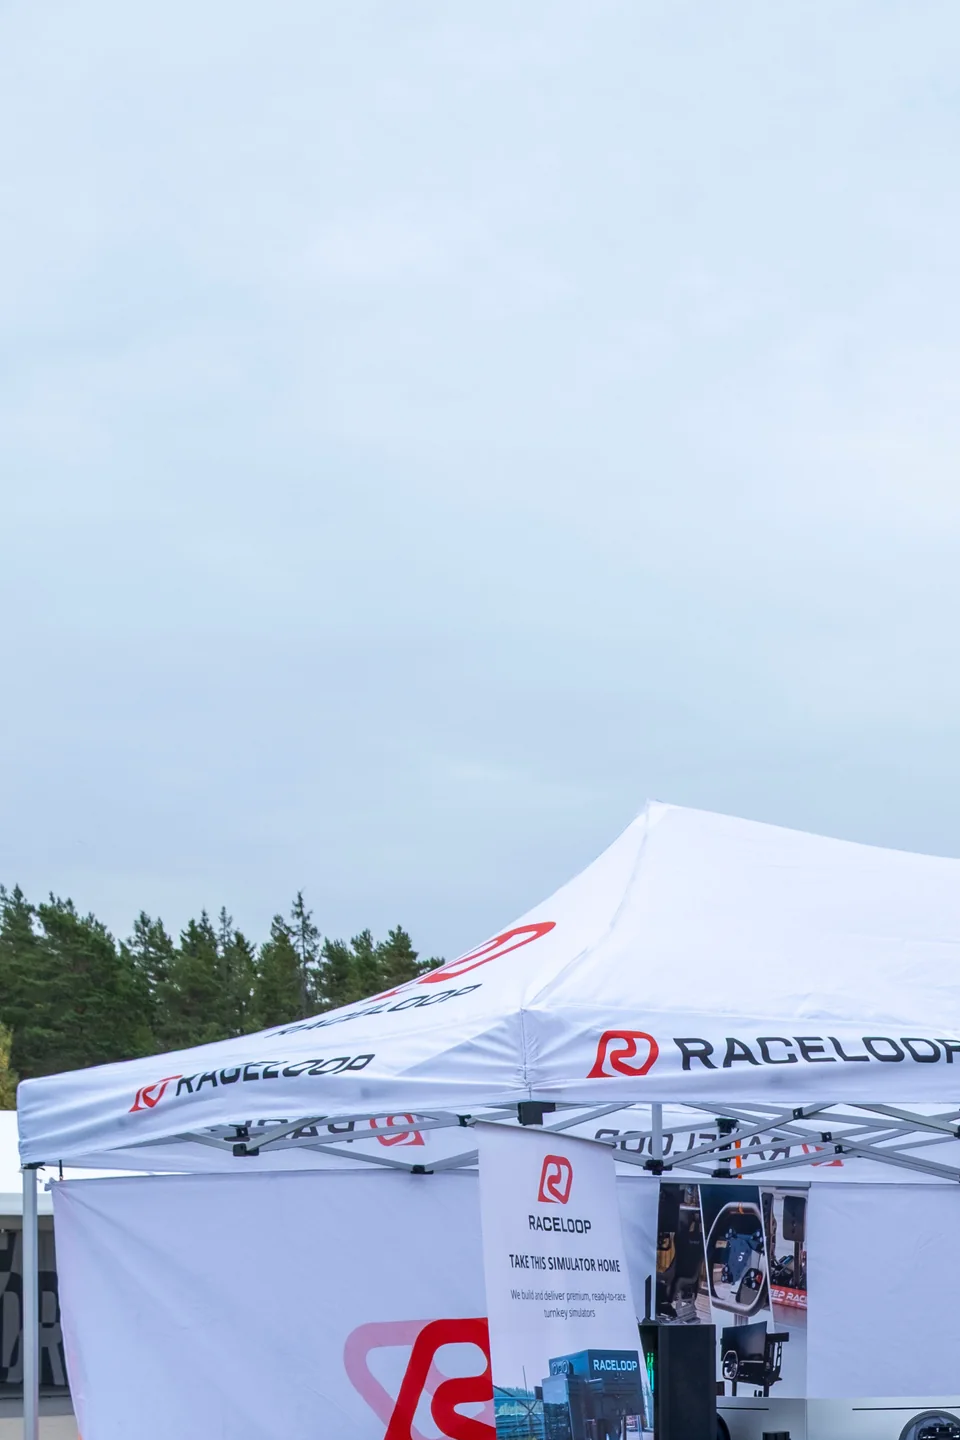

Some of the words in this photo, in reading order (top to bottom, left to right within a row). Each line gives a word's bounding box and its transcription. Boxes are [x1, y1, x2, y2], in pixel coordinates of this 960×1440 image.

[176, 1054, 376, 1097] RACELOOP
[528, 1215, 591, 1234] RACELOOP
[509, 1254, 529, 1269] TAKE
[531, 1256, 546, 1269] THIS
[549, 1256, 596, 1271] SIMULATOR
[598, 1260, 620, 1272] HOME
[511, 1290, 520, 1299] We
[522, 1290, 534, 1300] build
[544, 1290, 565, 1300] deliver
[567, 1292, 591, 1303] premium,
[592, 1292, 626, 1303] ready-to-race
[544, 1309, 567, 1320] turnkey
[569, 1308, 595, 1318] simulators
[594, 1360, 637, 1371] RACELOOP
